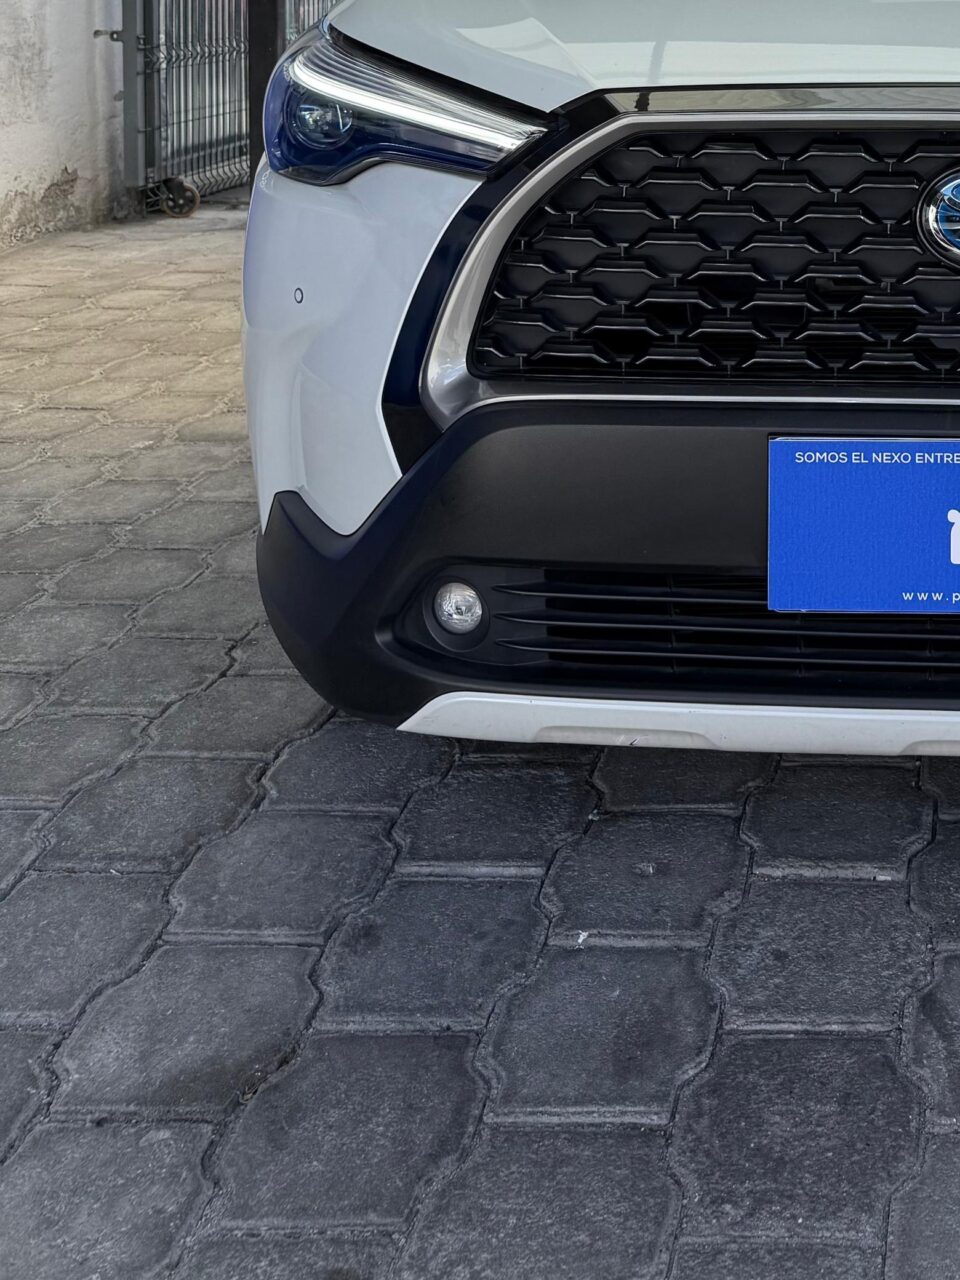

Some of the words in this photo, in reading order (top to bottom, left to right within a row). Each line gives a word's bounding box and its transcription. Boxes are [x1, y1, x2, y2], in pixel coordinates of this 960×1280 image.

[795, 451, 848, 464] SOMOS
[851, 451, 869, 464] EL
[872, 452, 912, 464] NEXO
